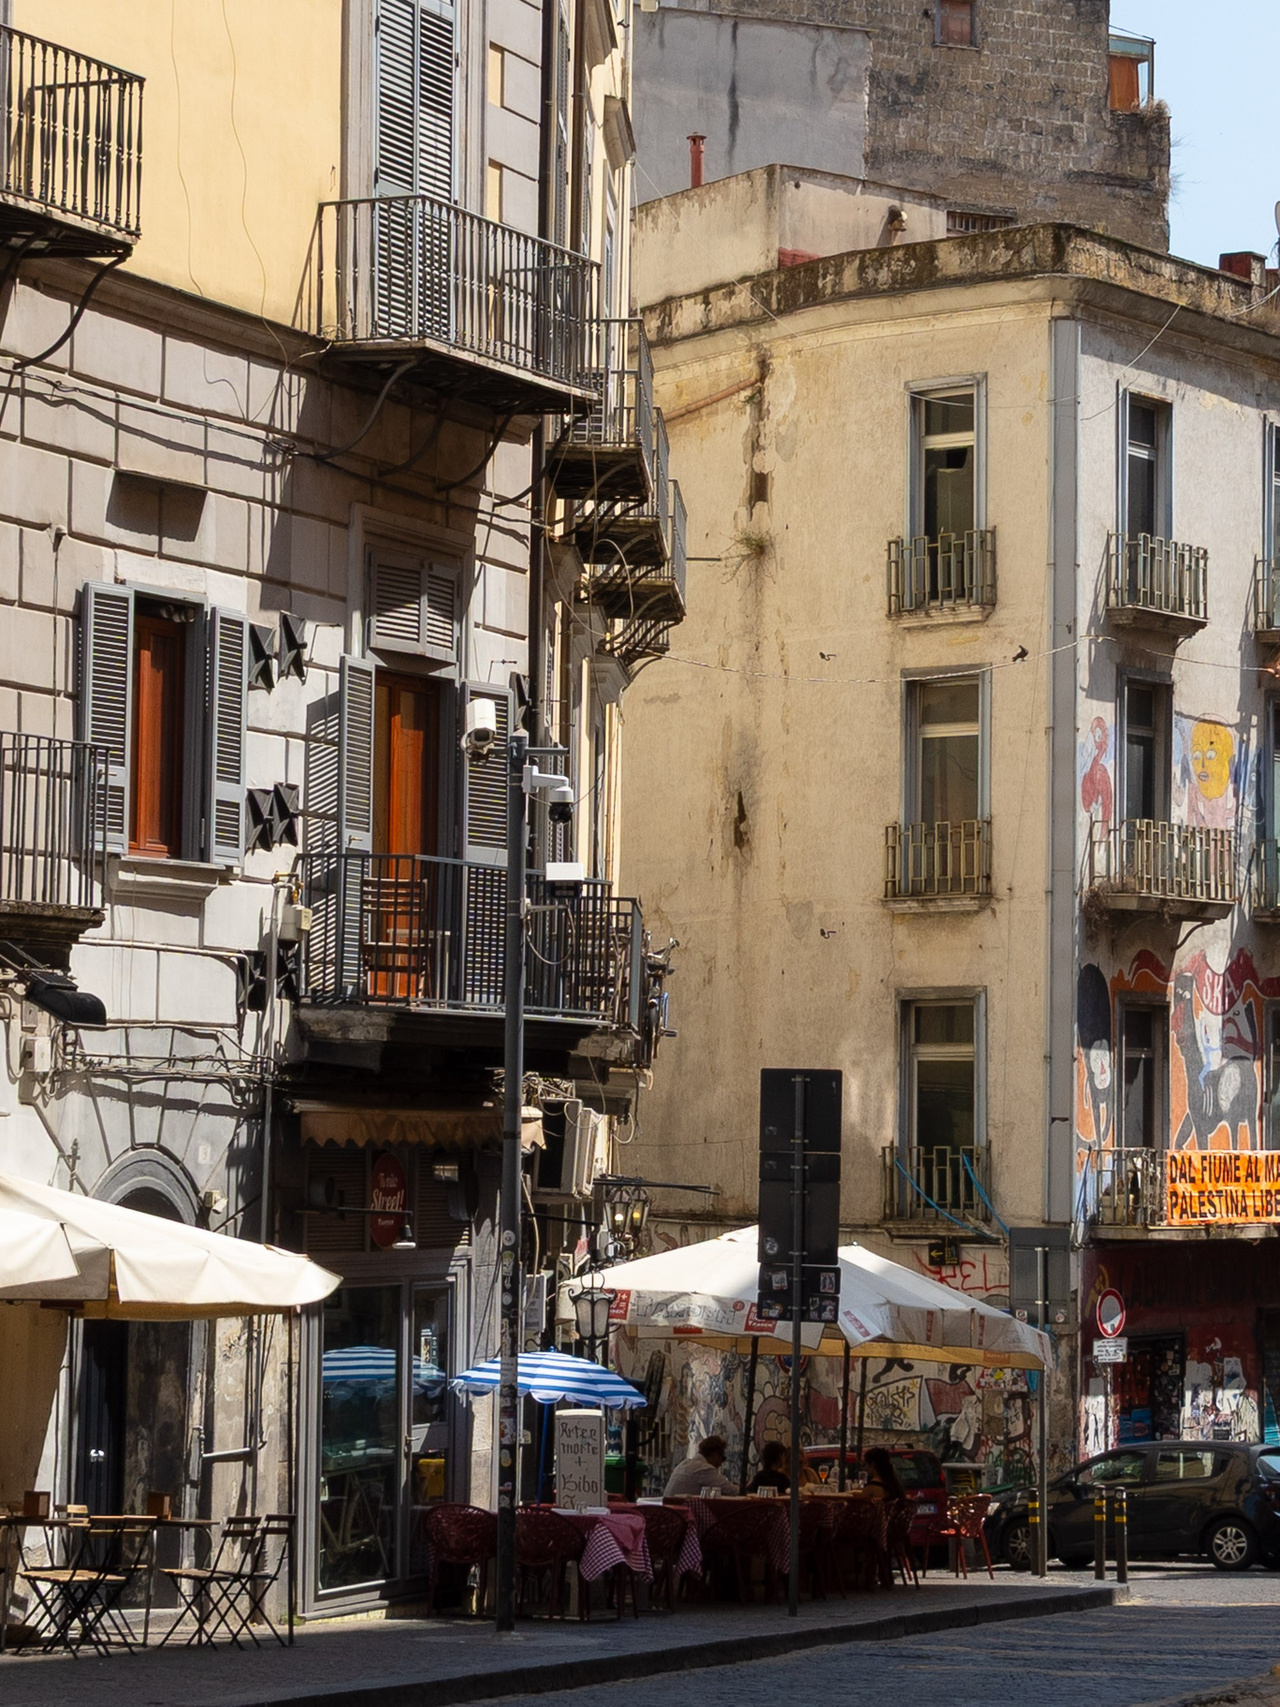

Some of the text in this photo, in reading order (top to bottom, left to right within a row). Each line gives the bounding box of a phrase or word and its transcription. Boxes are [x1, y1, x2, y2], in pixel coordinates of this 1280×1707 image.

[1169, 1155, 1196, 1184] DAL
[1200, 1154, 1241, 1184] FIUME
[1245, 1154, 1260, 1183] AL
[1169, 1189, 1249, 1219] PALESTINA
